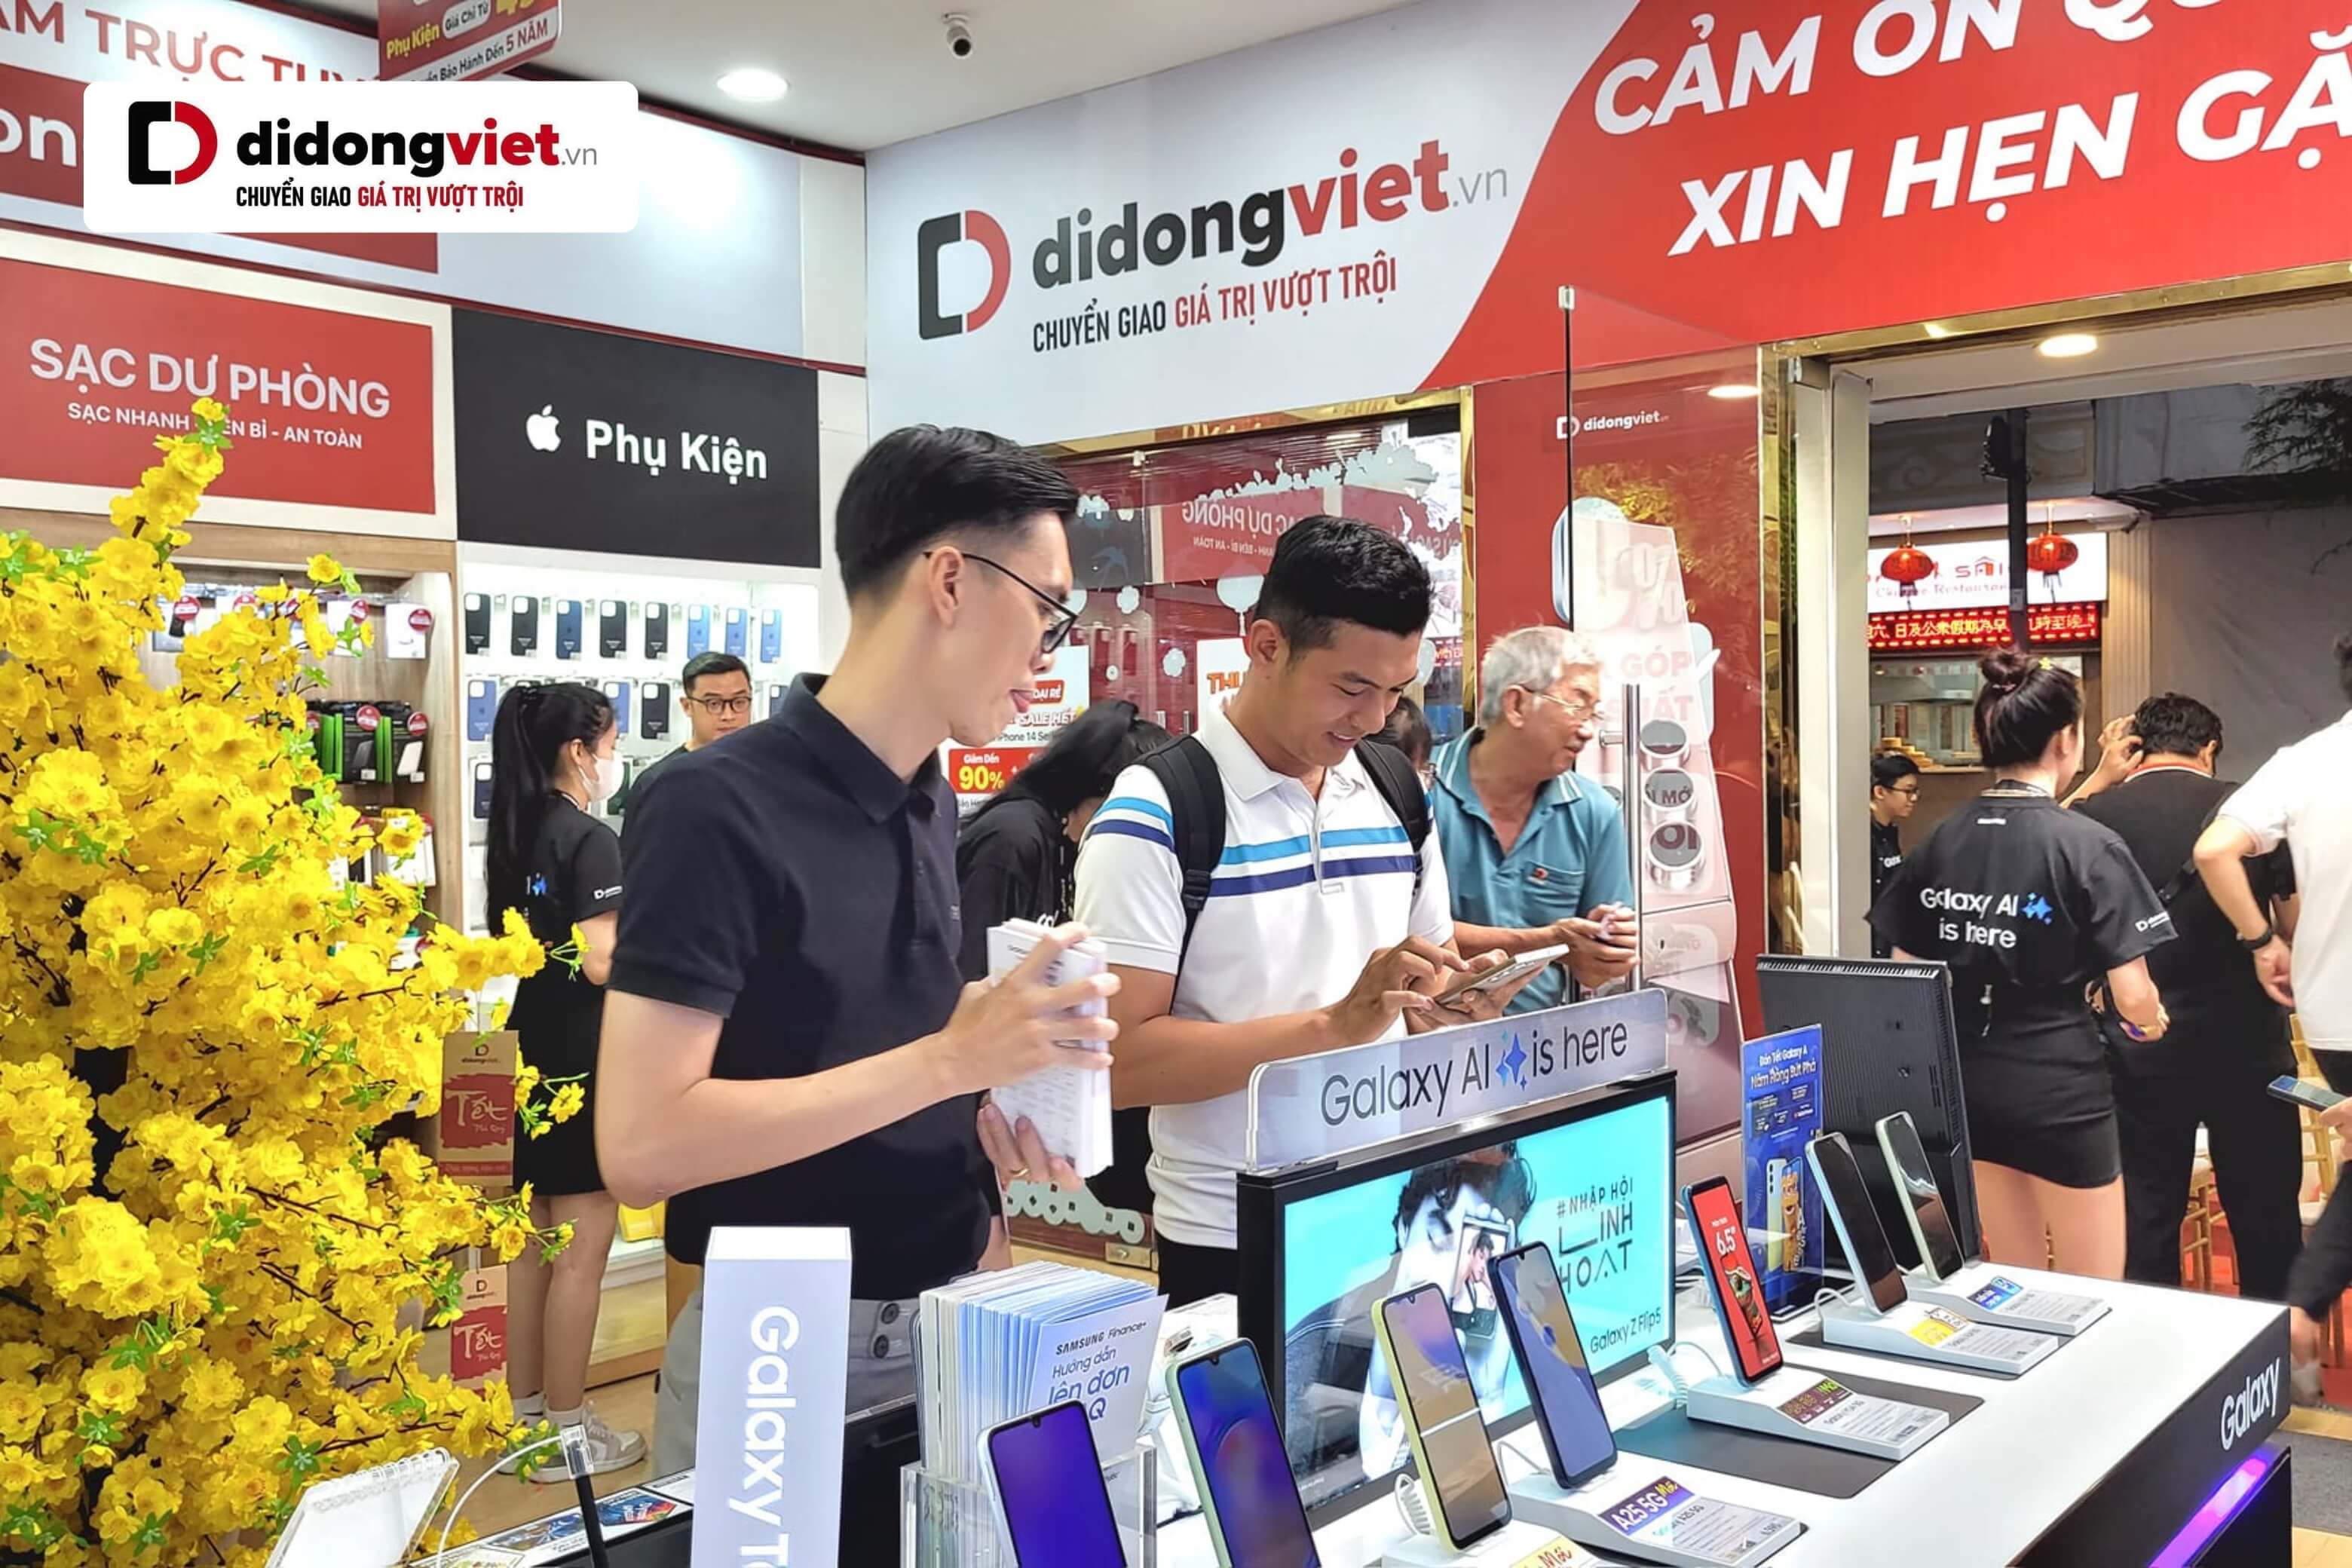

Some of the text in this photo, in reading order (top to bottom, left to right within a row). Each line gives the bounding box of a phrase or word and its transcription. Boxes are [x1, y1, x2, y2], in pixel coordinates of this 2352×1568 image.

[85, 9, 245, 81] TRỰC
[386, 23, 440, 60] Phụ Kiện
[506, 35, 516, 51] 5
[516, 17, 549, 49] NĂM
[1594, 13, 1821, 136] CẢM
[1667, 149, 1854, 257] XIN
[1881, 92, 2139, 223] HẸN
[1032, 139, 1508, 289] didongviet.vn
[1033, 250, 1397, 352] CHUYỂN GIAO GIÁ TRỊ VƯỢT TRỘI
[30, 338, 136, 394] SẠC
[230, 362, 390, 418] PHÒNG
[68, 403, 111, 425] SẠC
[116, 408, 189, 430] NHANH
[283, 427, 310, 443] AN
[314, 427, 363, 449] TOÀN
[586, 419, 767, 485] Phụ Kiện
[1027, 731, 1037, 741] 14
[959, 765, 1005, 790] 90%
[1996, 895, 2019, 917] AI
[1939, 917, 2017, 949] is here
[1320, 1022, 1628, 1127] Galaxy AI is here
[445, 1089, 509, 1126] Tết
[1611, 1176, 1633, 1202] HỘI
[1055, 1331, 1105, 1355] SAMSUNG
[1591, 1321, 1630, 1354] Galaxy
[1631, 1318, 1638, 1335] Z
[1048, 1365, 1130, 1404] lên đơn
[2221, 1357, 2280, 1450] Galaxy
[728, 1306, 800, 1568] Galaxy T
[1611, 1503, 1649, 1530] A25
[1637, 1492, 1669, 1512] 5G
